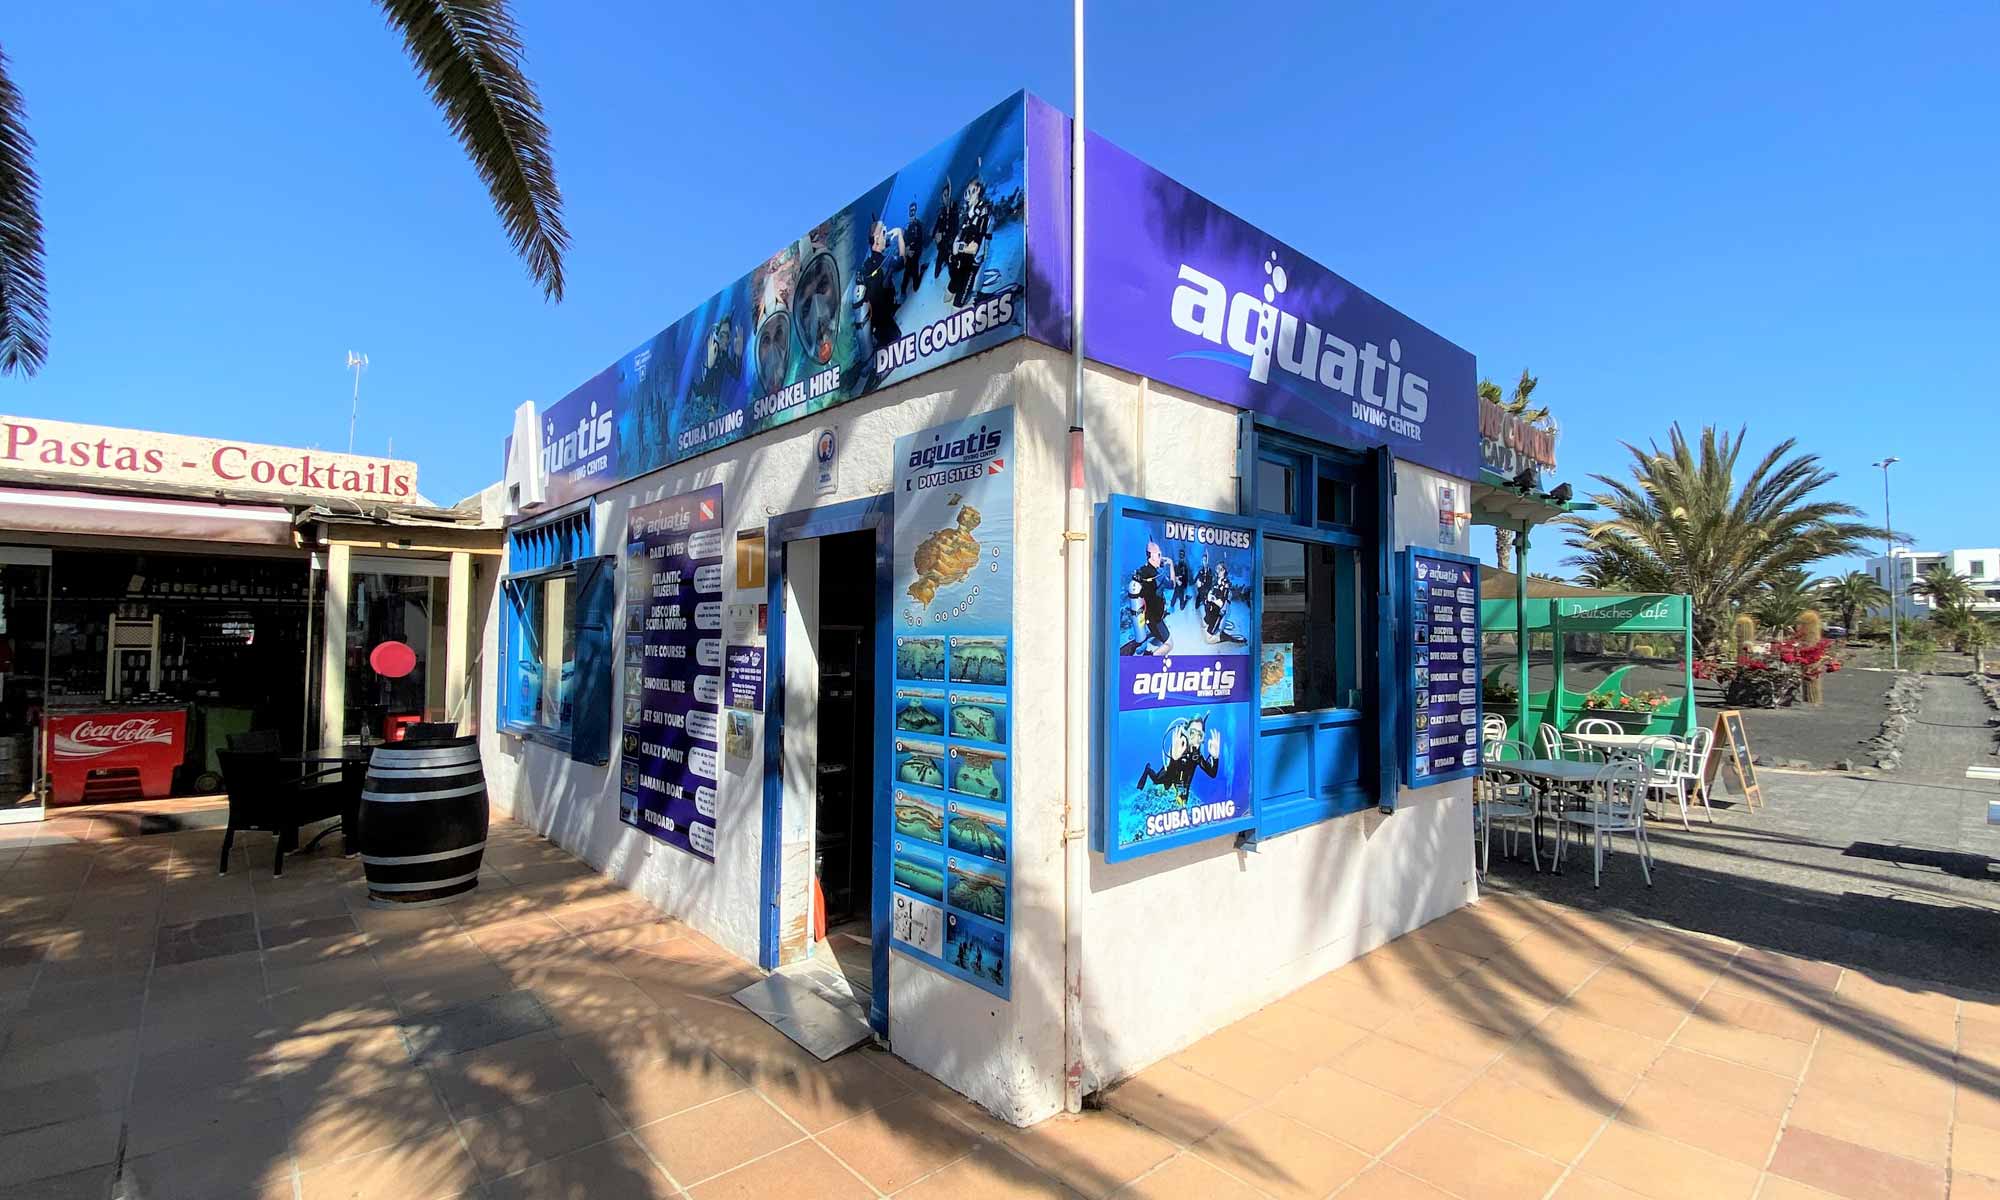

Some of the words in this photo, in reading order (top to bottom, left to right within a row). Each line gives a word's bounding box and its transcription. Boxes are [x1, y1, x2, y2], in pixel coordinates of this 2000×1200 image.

[876, 335, 916, 374] DIVE
[920, 293, 1012, 355] COURSES
[1171, 260, 1429, 423] aquatis
[753, 381, 807, 420] SNORKEL
[809, 366, 841, 398] HIRE
[678, 429, 707, 451] SCUBA
[708, 409, 744, 438] DIVING
[1352, 401, 1387, 428] DIVING
[1389, 416, 1421, 441] CENTER
[909, 425, 1002, 468] aquatis
[2, 423, 164, 473] Pastas
[212, 446, 409, 497] Cocktails
[587, 455, 608, 475] CENTER
[918, 474, 946, 490] DIVE
[948, 464, 983, 483] SITES
[648, 506, 691, 536] aquatis
[1166, 521, 1195, 542] DIVE
[1197, 527, 1250, 550] COURSES
[666, 542, 685, 556] DIVES
[651, 570, 682, 585] ATLANTIC
[653, 583, 680, 598] MUSEUM
[645, 618, 664, 630] SCUBA
[664, 617, 687, 630] DIVING
[651, 604, 681, 618] DISCOVER
[1572, 604, 1633, 619] Deutsches
[1639, 602, 1670, 620] Café
[644, 644, 658, 657] DIVE
[659, 645, 686, 659] COURSES
[644, 677, 671, 692] SNORKEL
[671, 680, 686, 694] HIRE
[1133, 660, 1236, 700] aquatis
[70, 718, 162, 744] Coca-Cola
[643, 709, 653, 722] JET
[653, 711, 663, 725] SKI
[664, 713, 685, 729] TOURS
[641, 742, 662, 758] CRAZY
[662, 746, 684, 763] DONUT
[640, 773, 666, 793] BANANA
[666, 782, 684, 800] BOAT
[1147, 809, 1190, 836] SCUBA
[1191, 800, 1235, 825] DIVING
